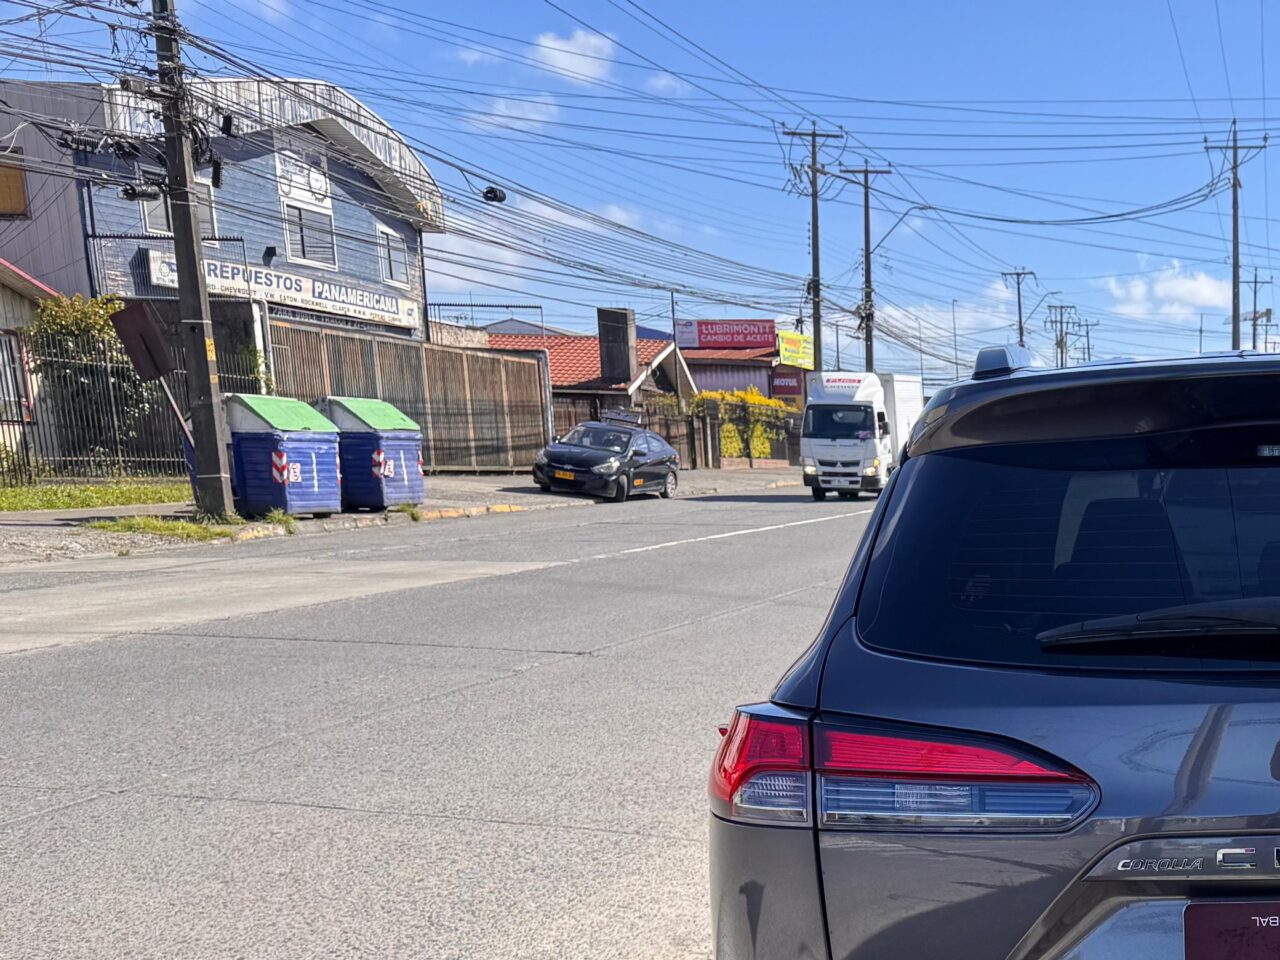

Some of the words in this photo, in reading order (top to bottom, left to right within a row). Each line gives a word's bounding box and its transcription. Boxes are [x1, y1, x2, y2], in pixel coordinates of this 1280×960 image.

[206, 261, 303, 293] REPUESTOS
[314, 281, 398, 313] PANAMERICANA
[220, 285, 256, 296] CHEVROLT
[701, 333, 731, 342] CAMBIO
[733, 333, 744, 342] DE
[745, 333, 774, 342] ACEITE
[774, 378, 798, 387] MOTUL
[1117, 857, 1203, 872] COROLLA
